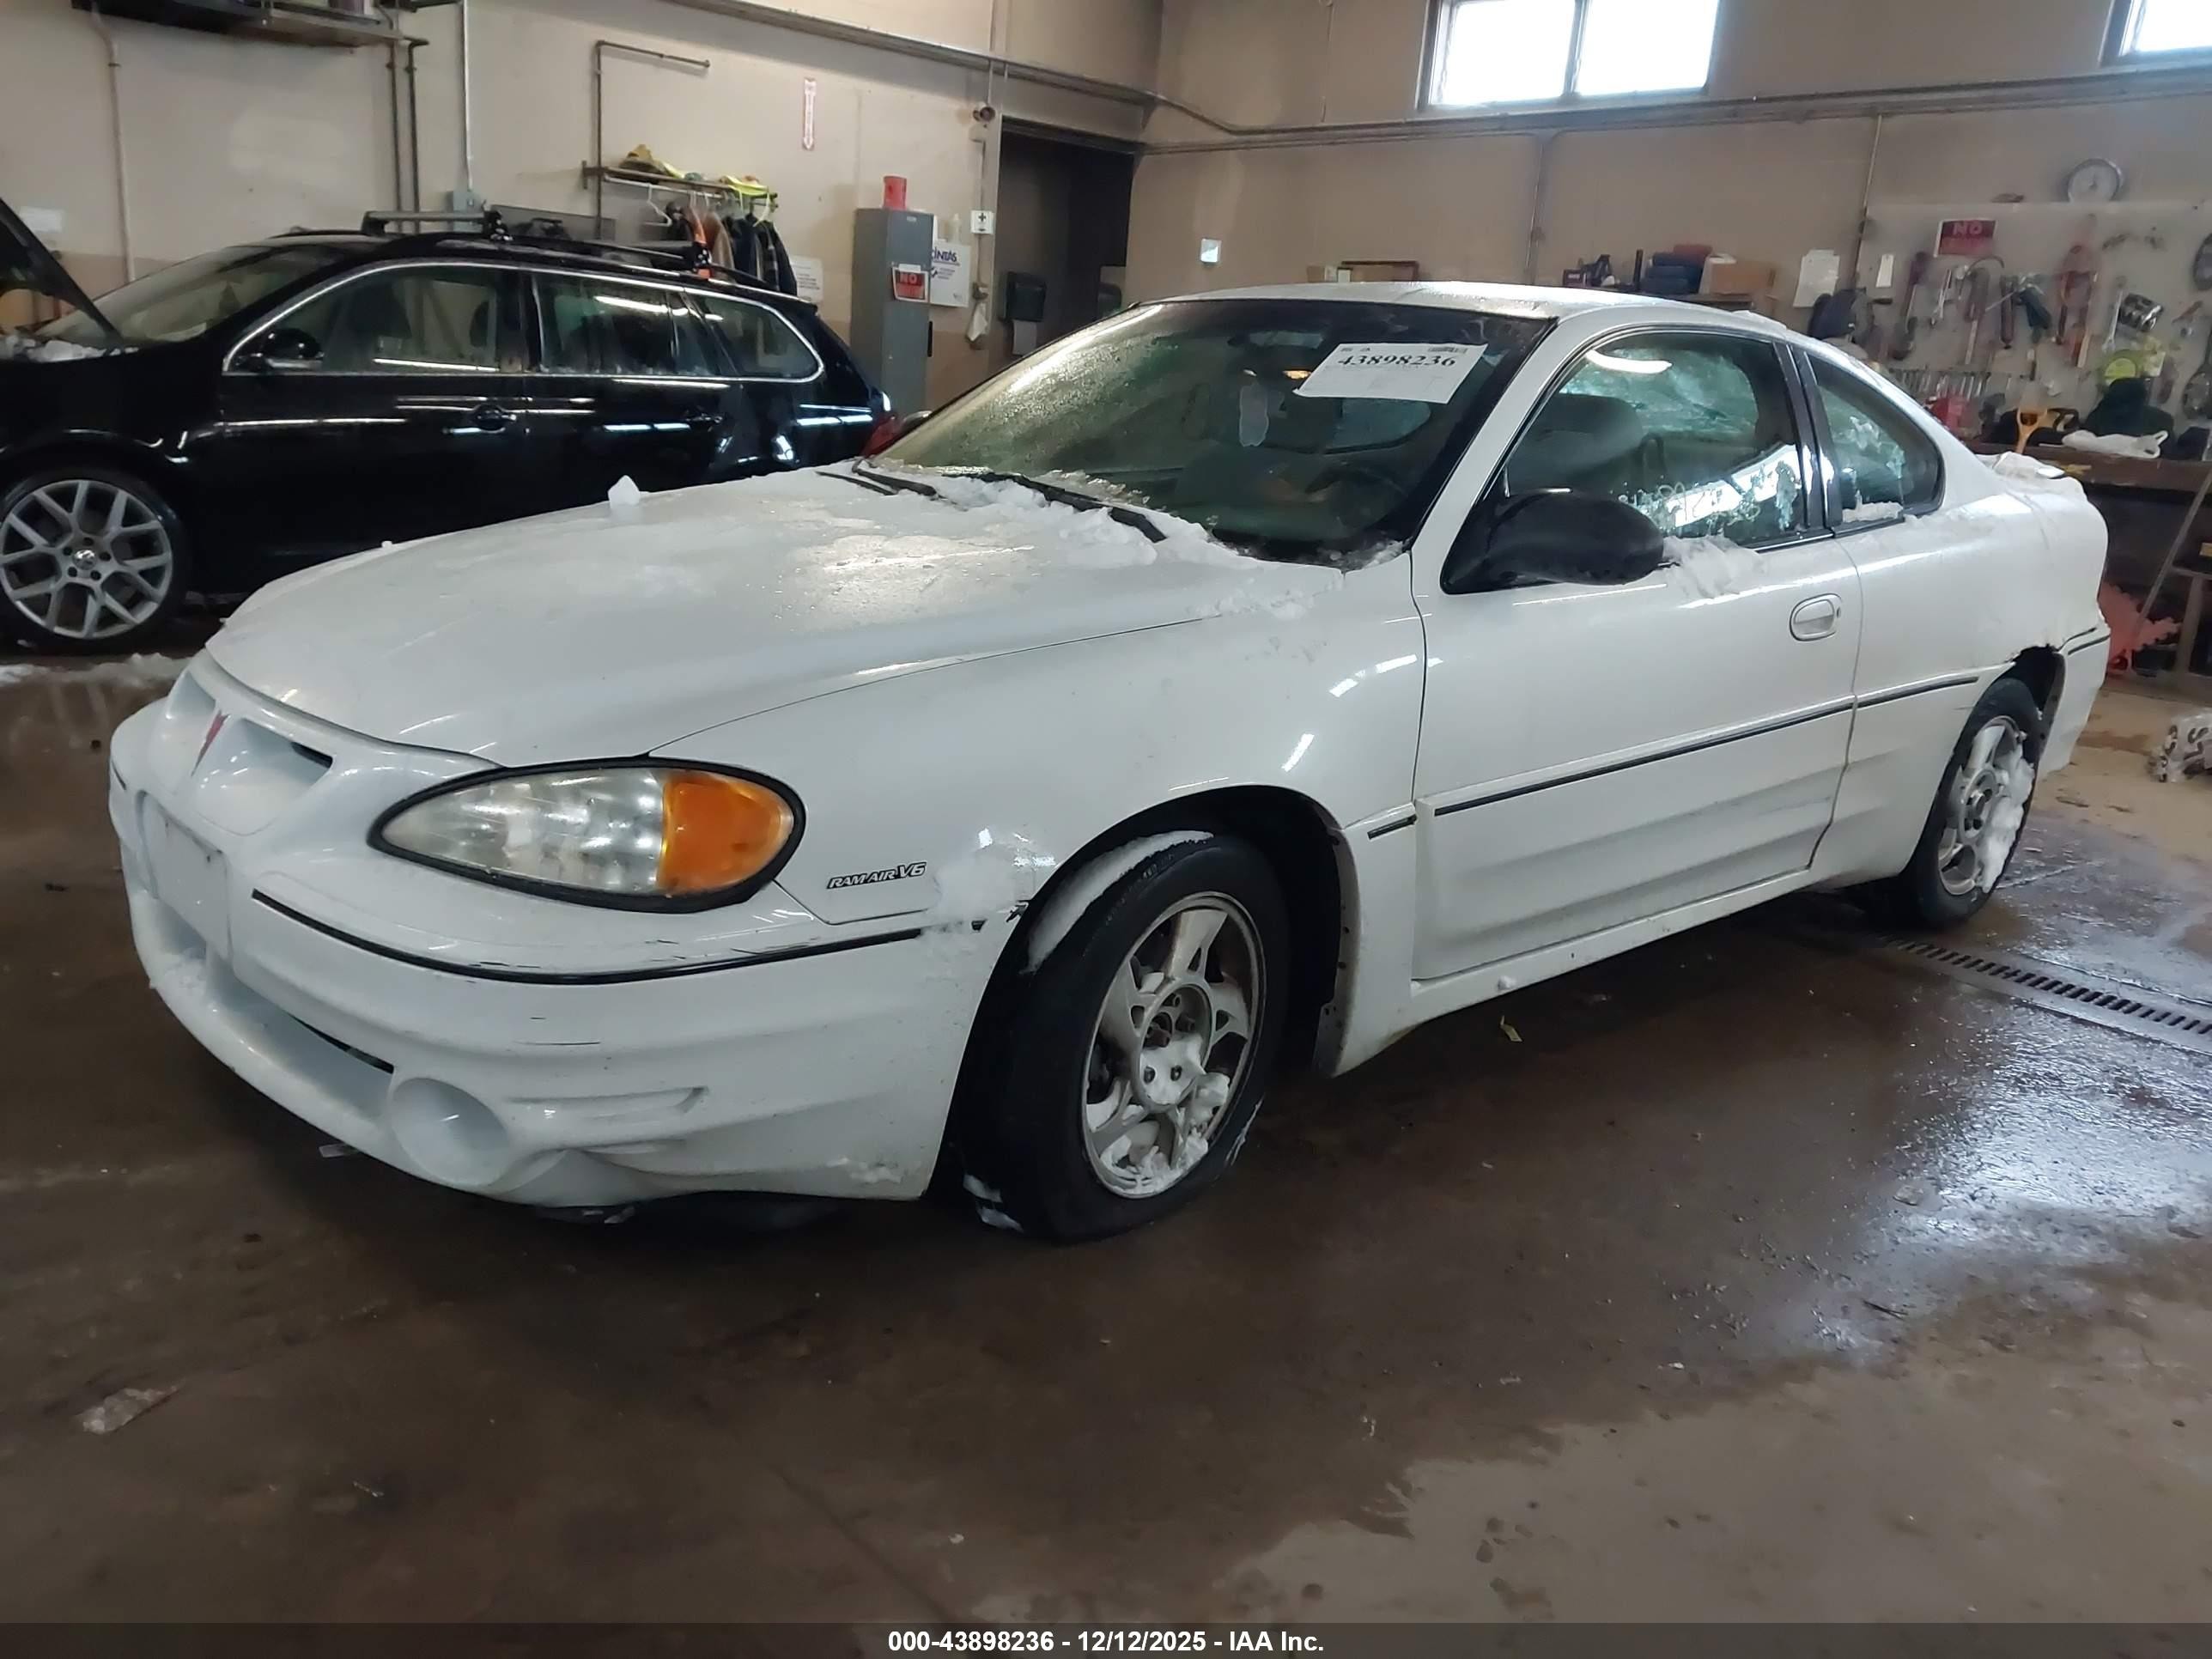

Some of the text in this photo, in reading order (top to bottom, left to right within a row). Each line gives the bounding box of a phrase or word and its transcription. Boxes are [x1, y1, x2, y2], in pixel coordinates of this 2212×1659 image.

[1953, 221, 1983, 234] NO
[933, 246, 957, 262] INTAS
[900, 273, 918, 284] NO
[1338, 355, 1456, 367] 43898236
[897, 861, 927, 878] V6
